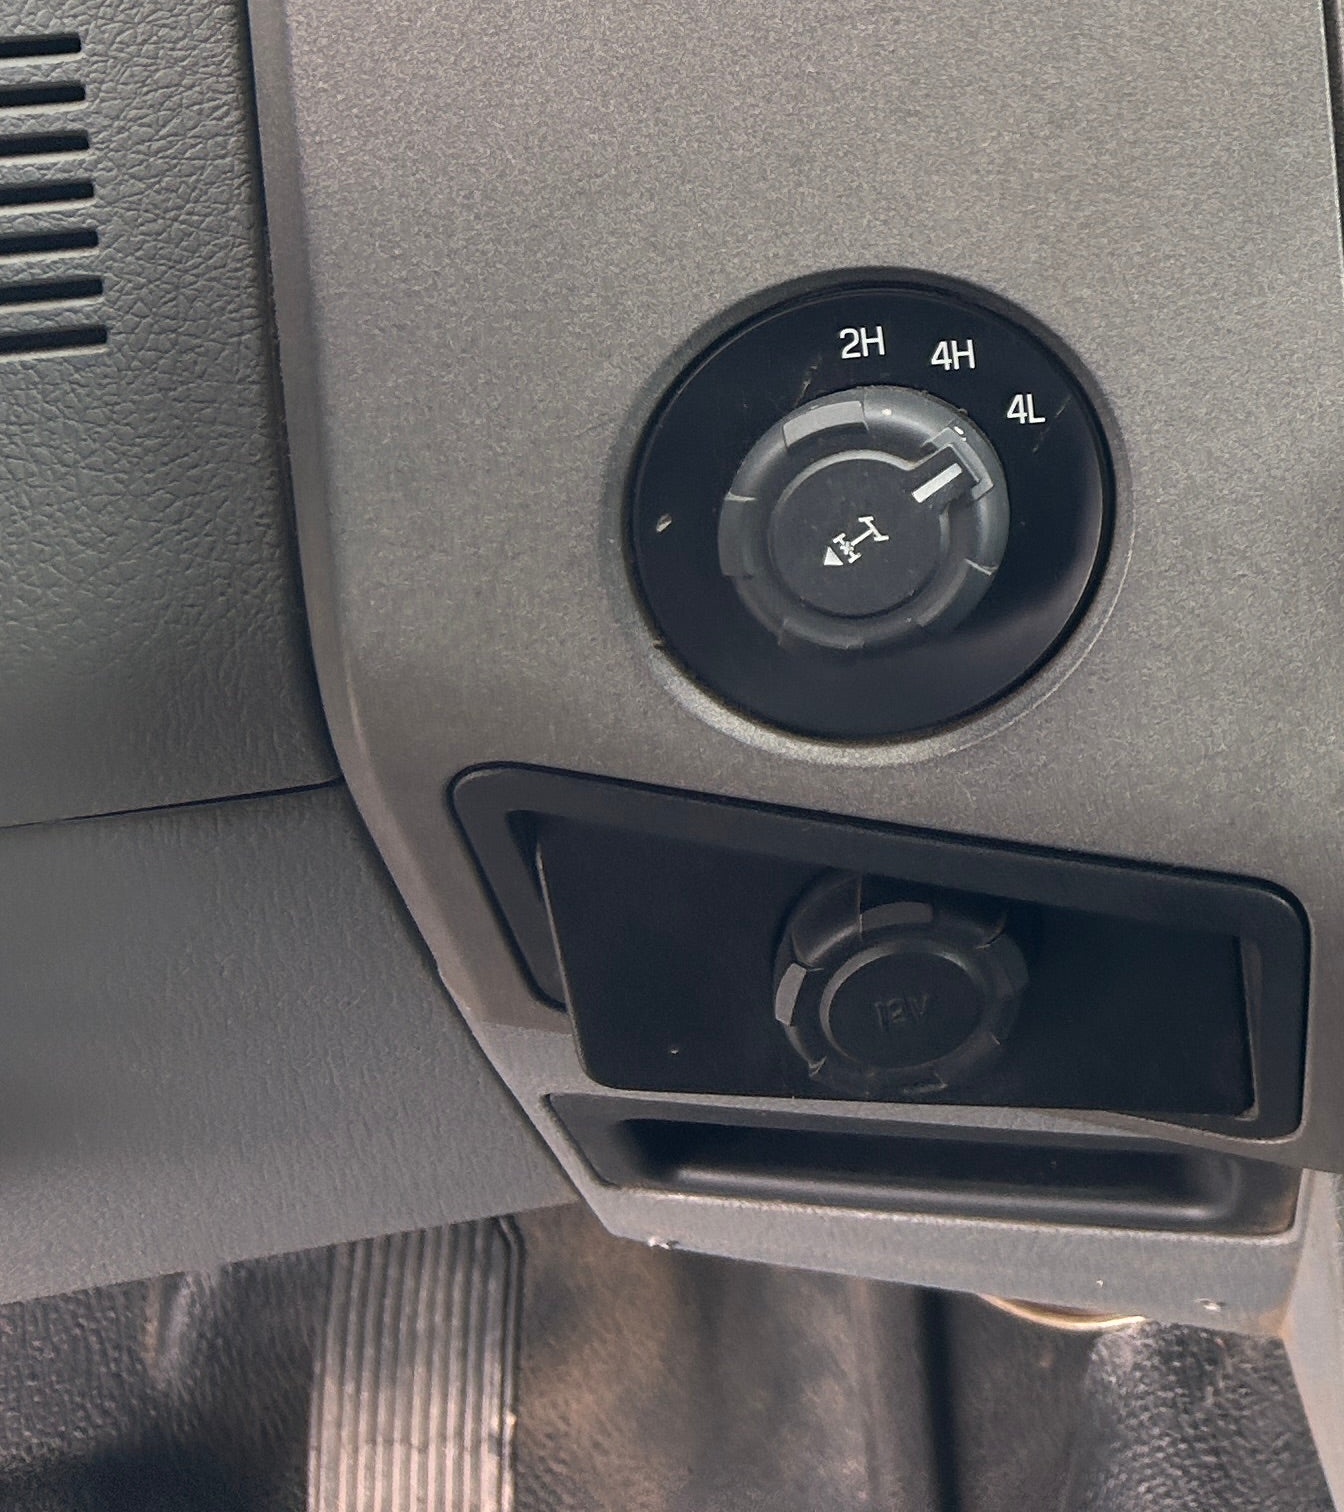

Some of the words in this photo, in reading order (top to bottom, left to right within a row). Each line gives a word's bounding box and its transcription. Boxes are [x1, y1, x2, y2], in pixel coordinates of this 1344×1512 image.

[838, 325, 886, 360] 2H
[930, 338, 976, 372] 4H
[1005, 392, 1046, 425] 4L
